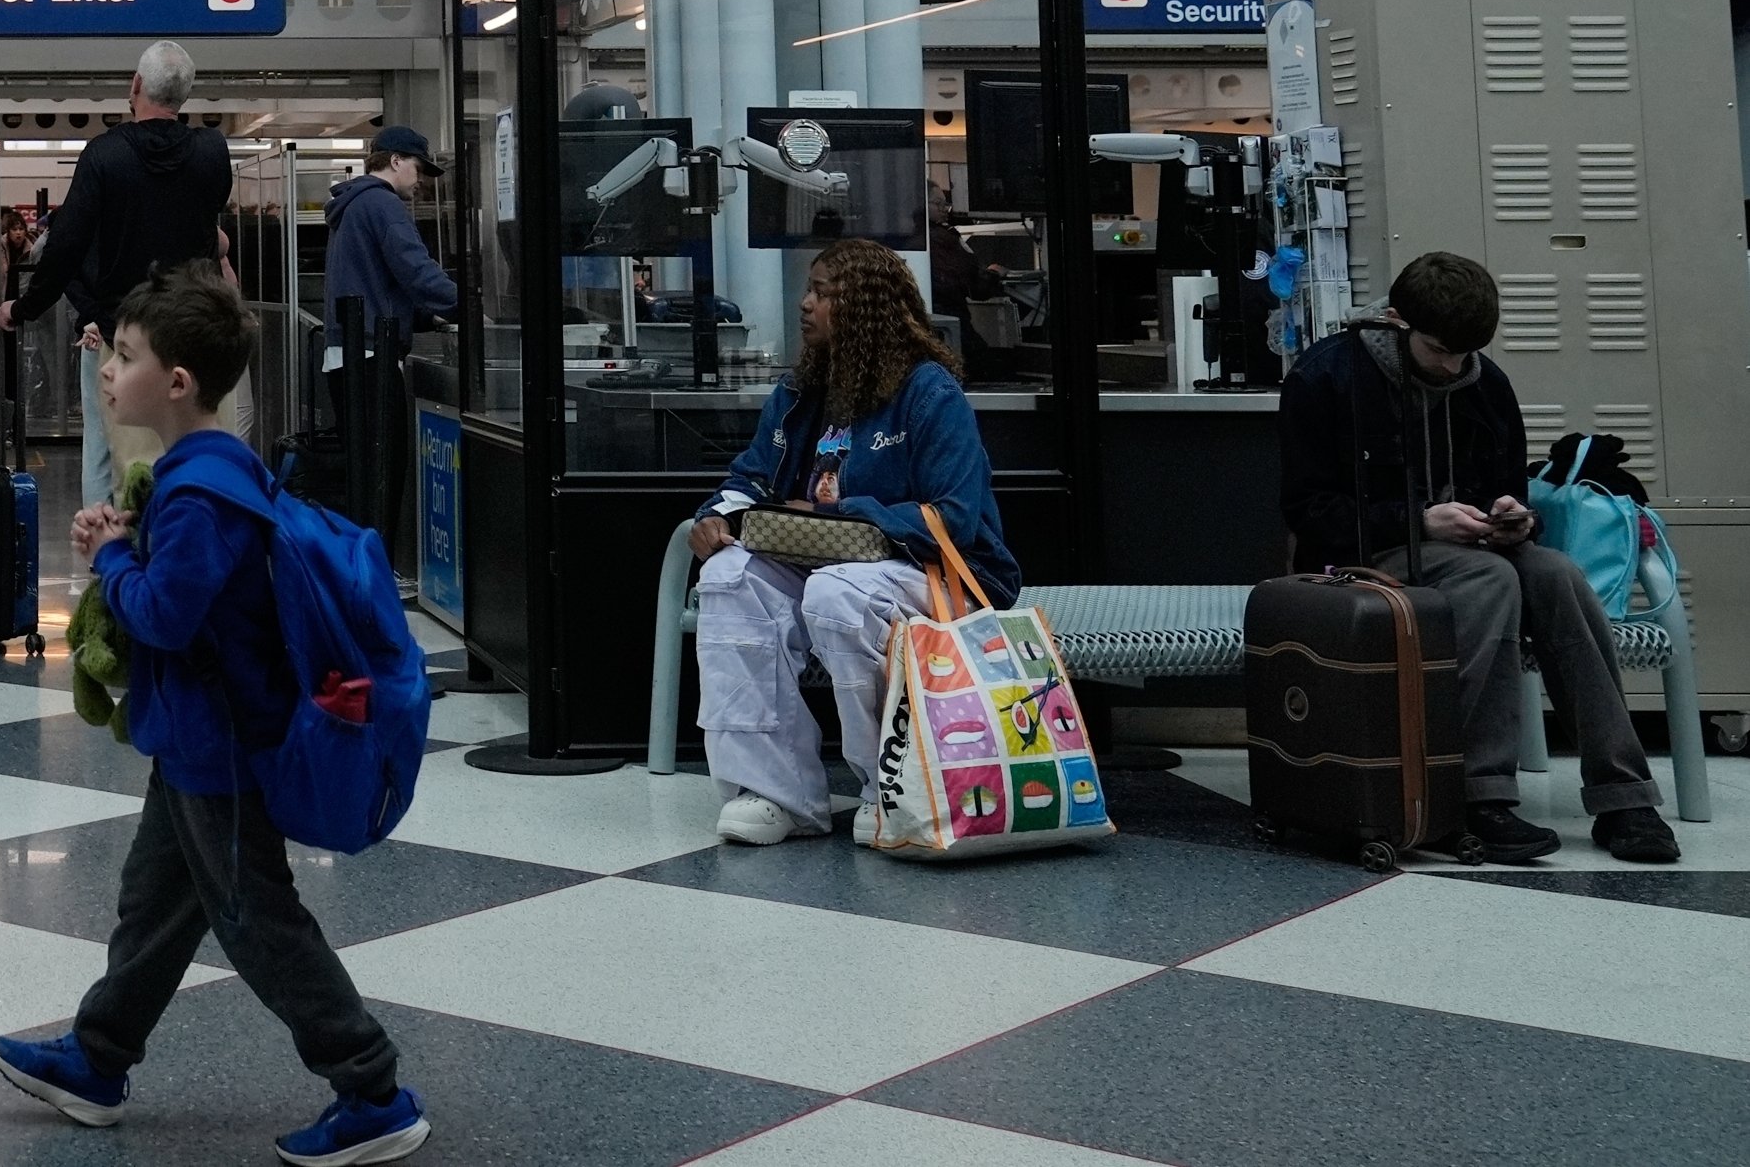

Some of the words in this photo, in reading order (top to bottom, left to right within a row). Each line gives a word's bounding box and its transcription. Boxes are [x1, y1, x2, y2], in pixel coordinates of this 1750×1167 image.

[427, 427, 453, 474] Return
[431, 472, 446, 516] bin
[430, 515, 450, 563] here
